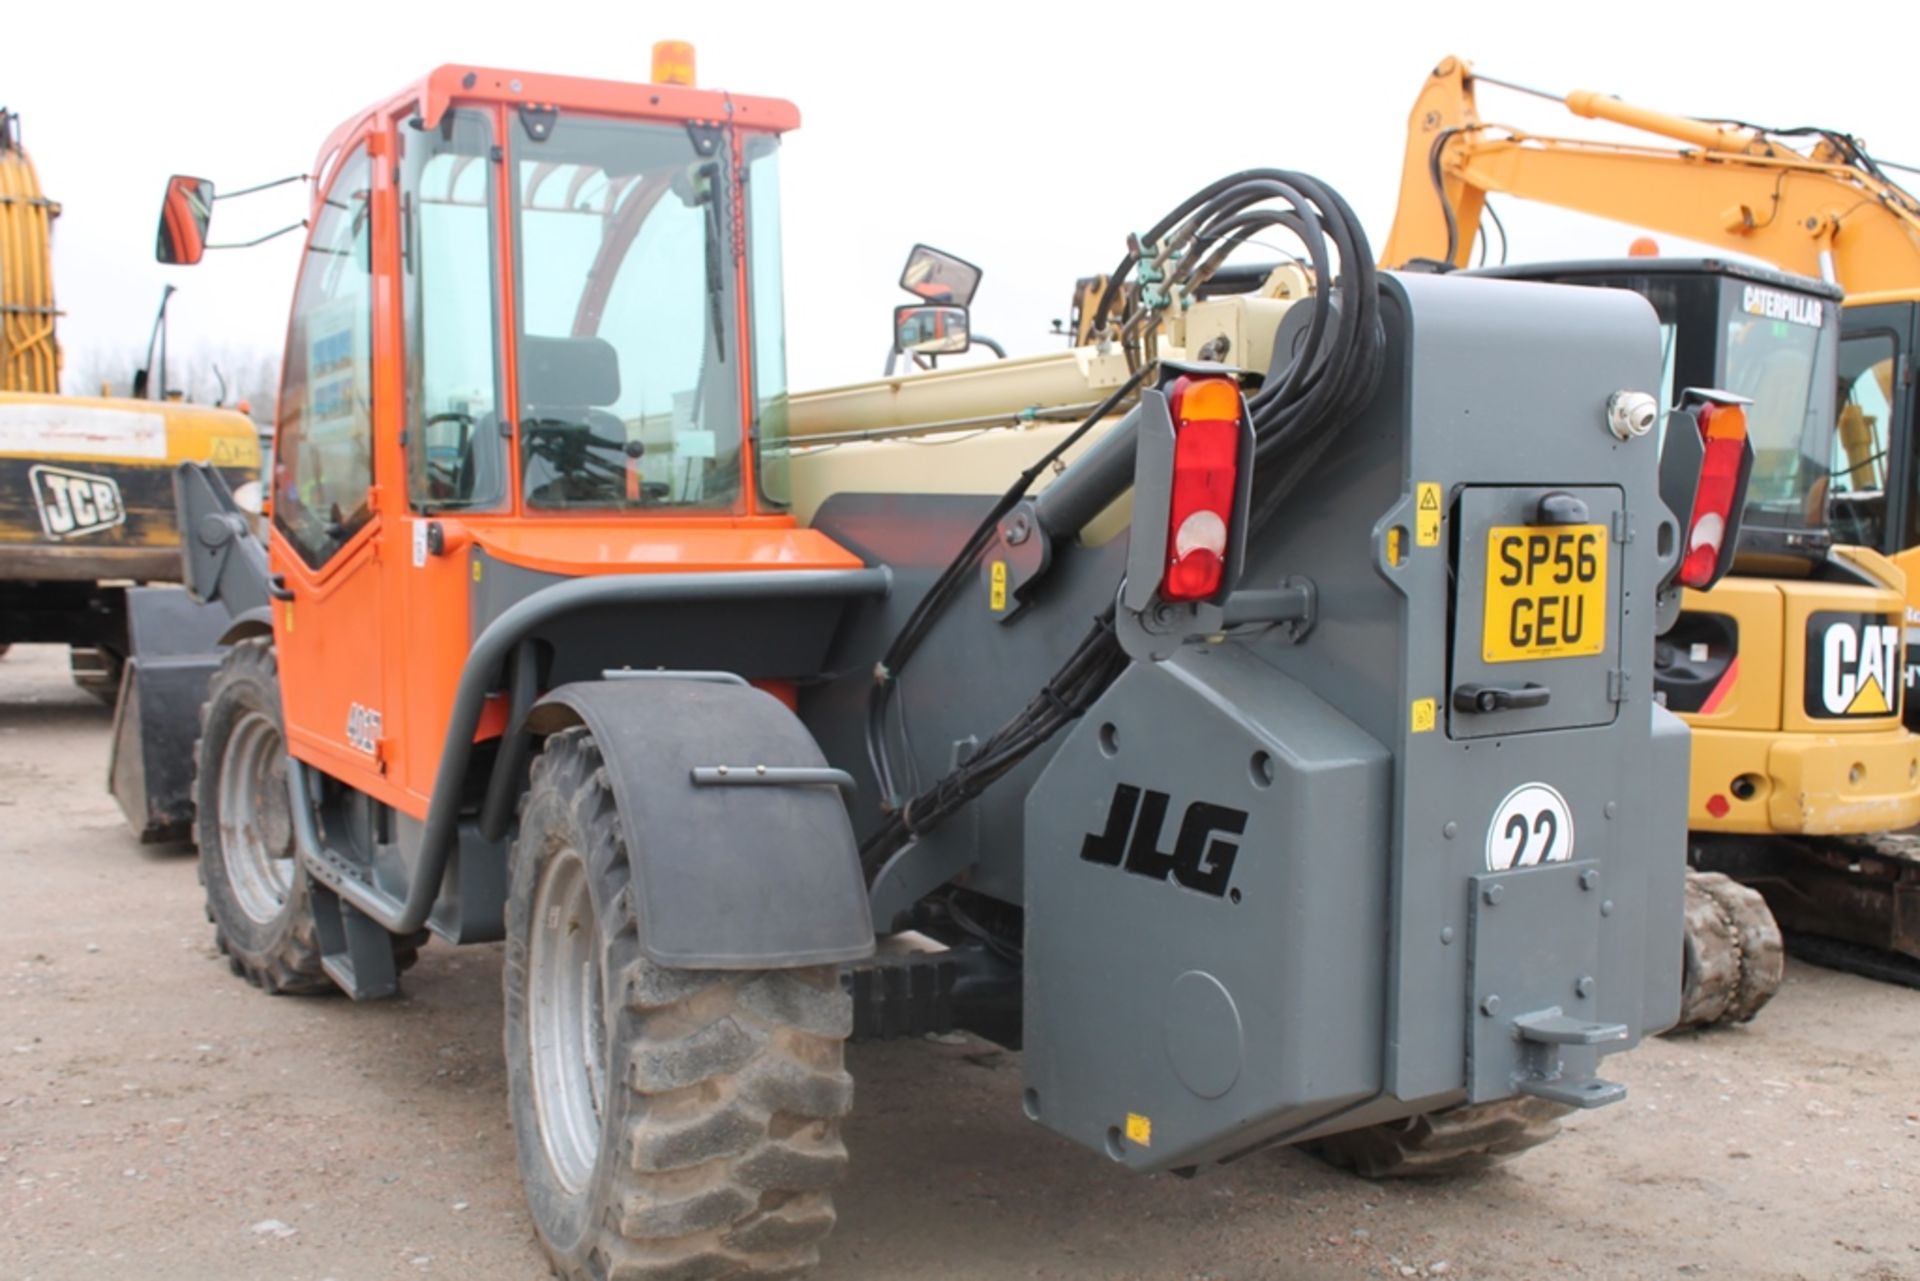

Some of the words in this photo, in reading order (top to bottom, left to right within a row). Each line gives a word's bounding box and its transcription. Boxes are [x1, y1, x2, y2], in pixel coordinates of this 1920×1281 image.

[1744, 285, 1823, 328] CATERPILLAR
[44, 474, 118, 533] JCB
[1500, 534, 1596, 587] SP56
[1510, 594, 1583, 648] GEU
[1823, 622, 1899, 715] CAT
[1504, 808, 1557, 869] 22
